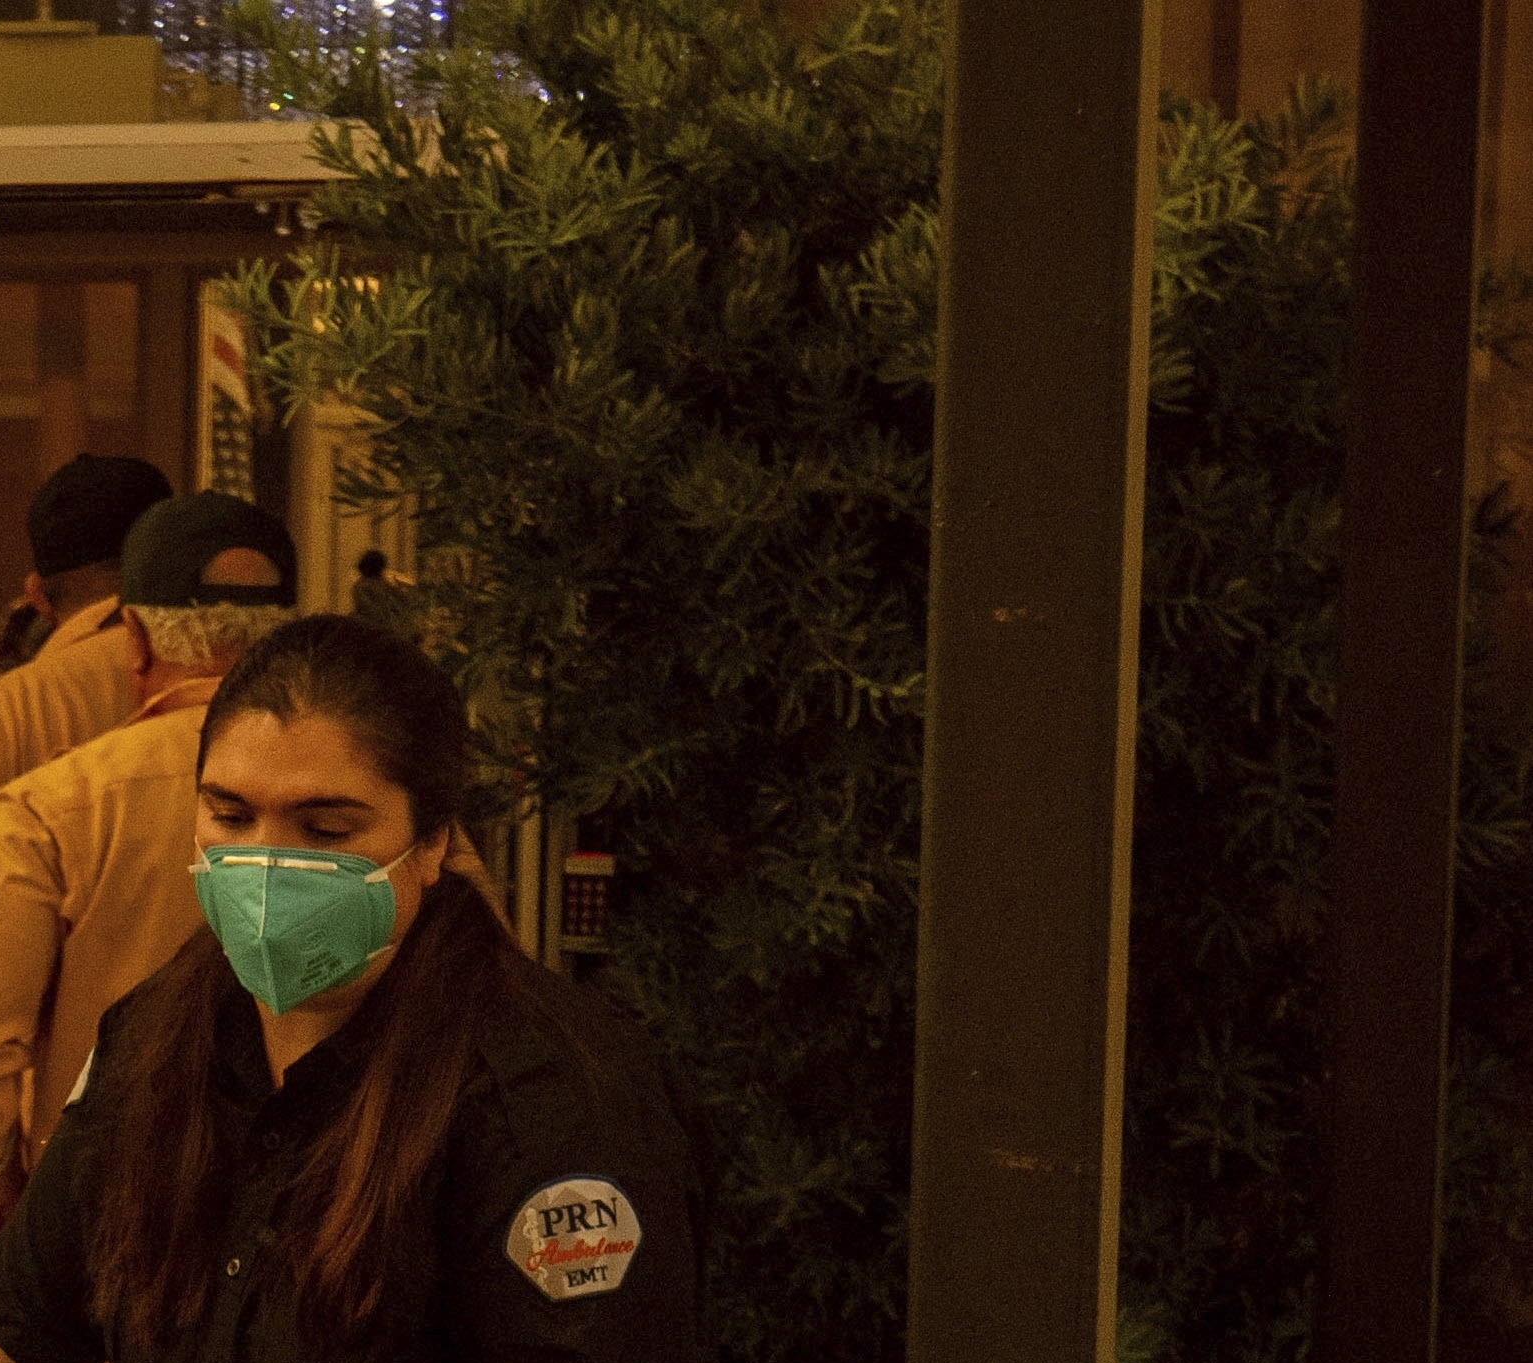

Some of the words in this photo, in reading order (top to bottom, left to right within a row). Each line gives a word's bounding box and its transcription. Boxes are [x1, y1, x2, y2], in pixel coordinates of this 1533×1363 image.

[539, 1197, 618, 1238] PRN
[526, 1237, 635, 1272] Ambulance
[566, 1266, 609, 1288] EMT
